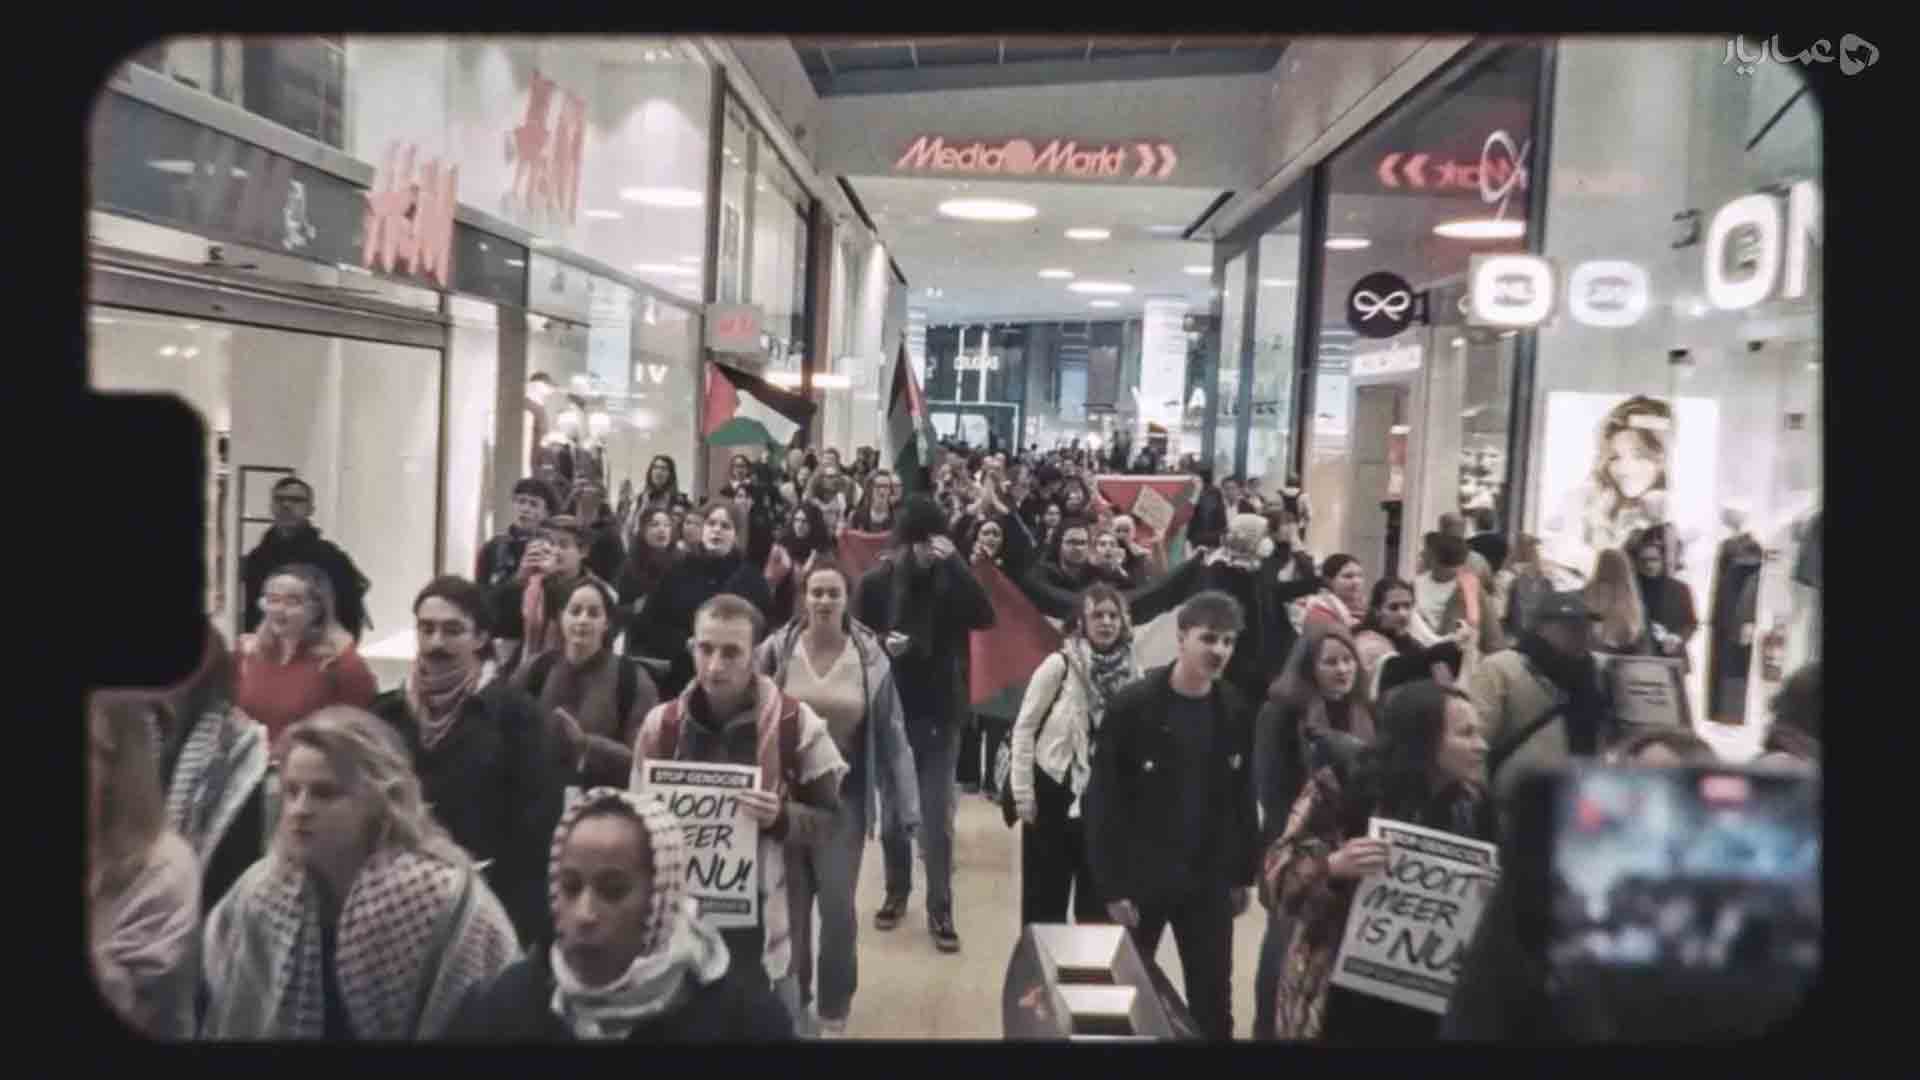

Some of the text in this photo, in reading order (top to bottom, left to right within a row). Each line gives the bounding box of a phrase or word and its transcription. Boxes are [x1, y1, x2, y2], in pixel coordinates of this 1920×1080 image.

[895, 135, 1002, 170] Media
[682, 823, 734, 849] EER
[685, 852, 752, 892] NU!
[1361, 883, 1460, 929] MEER
[1356, 915, 1393, 945] IS
